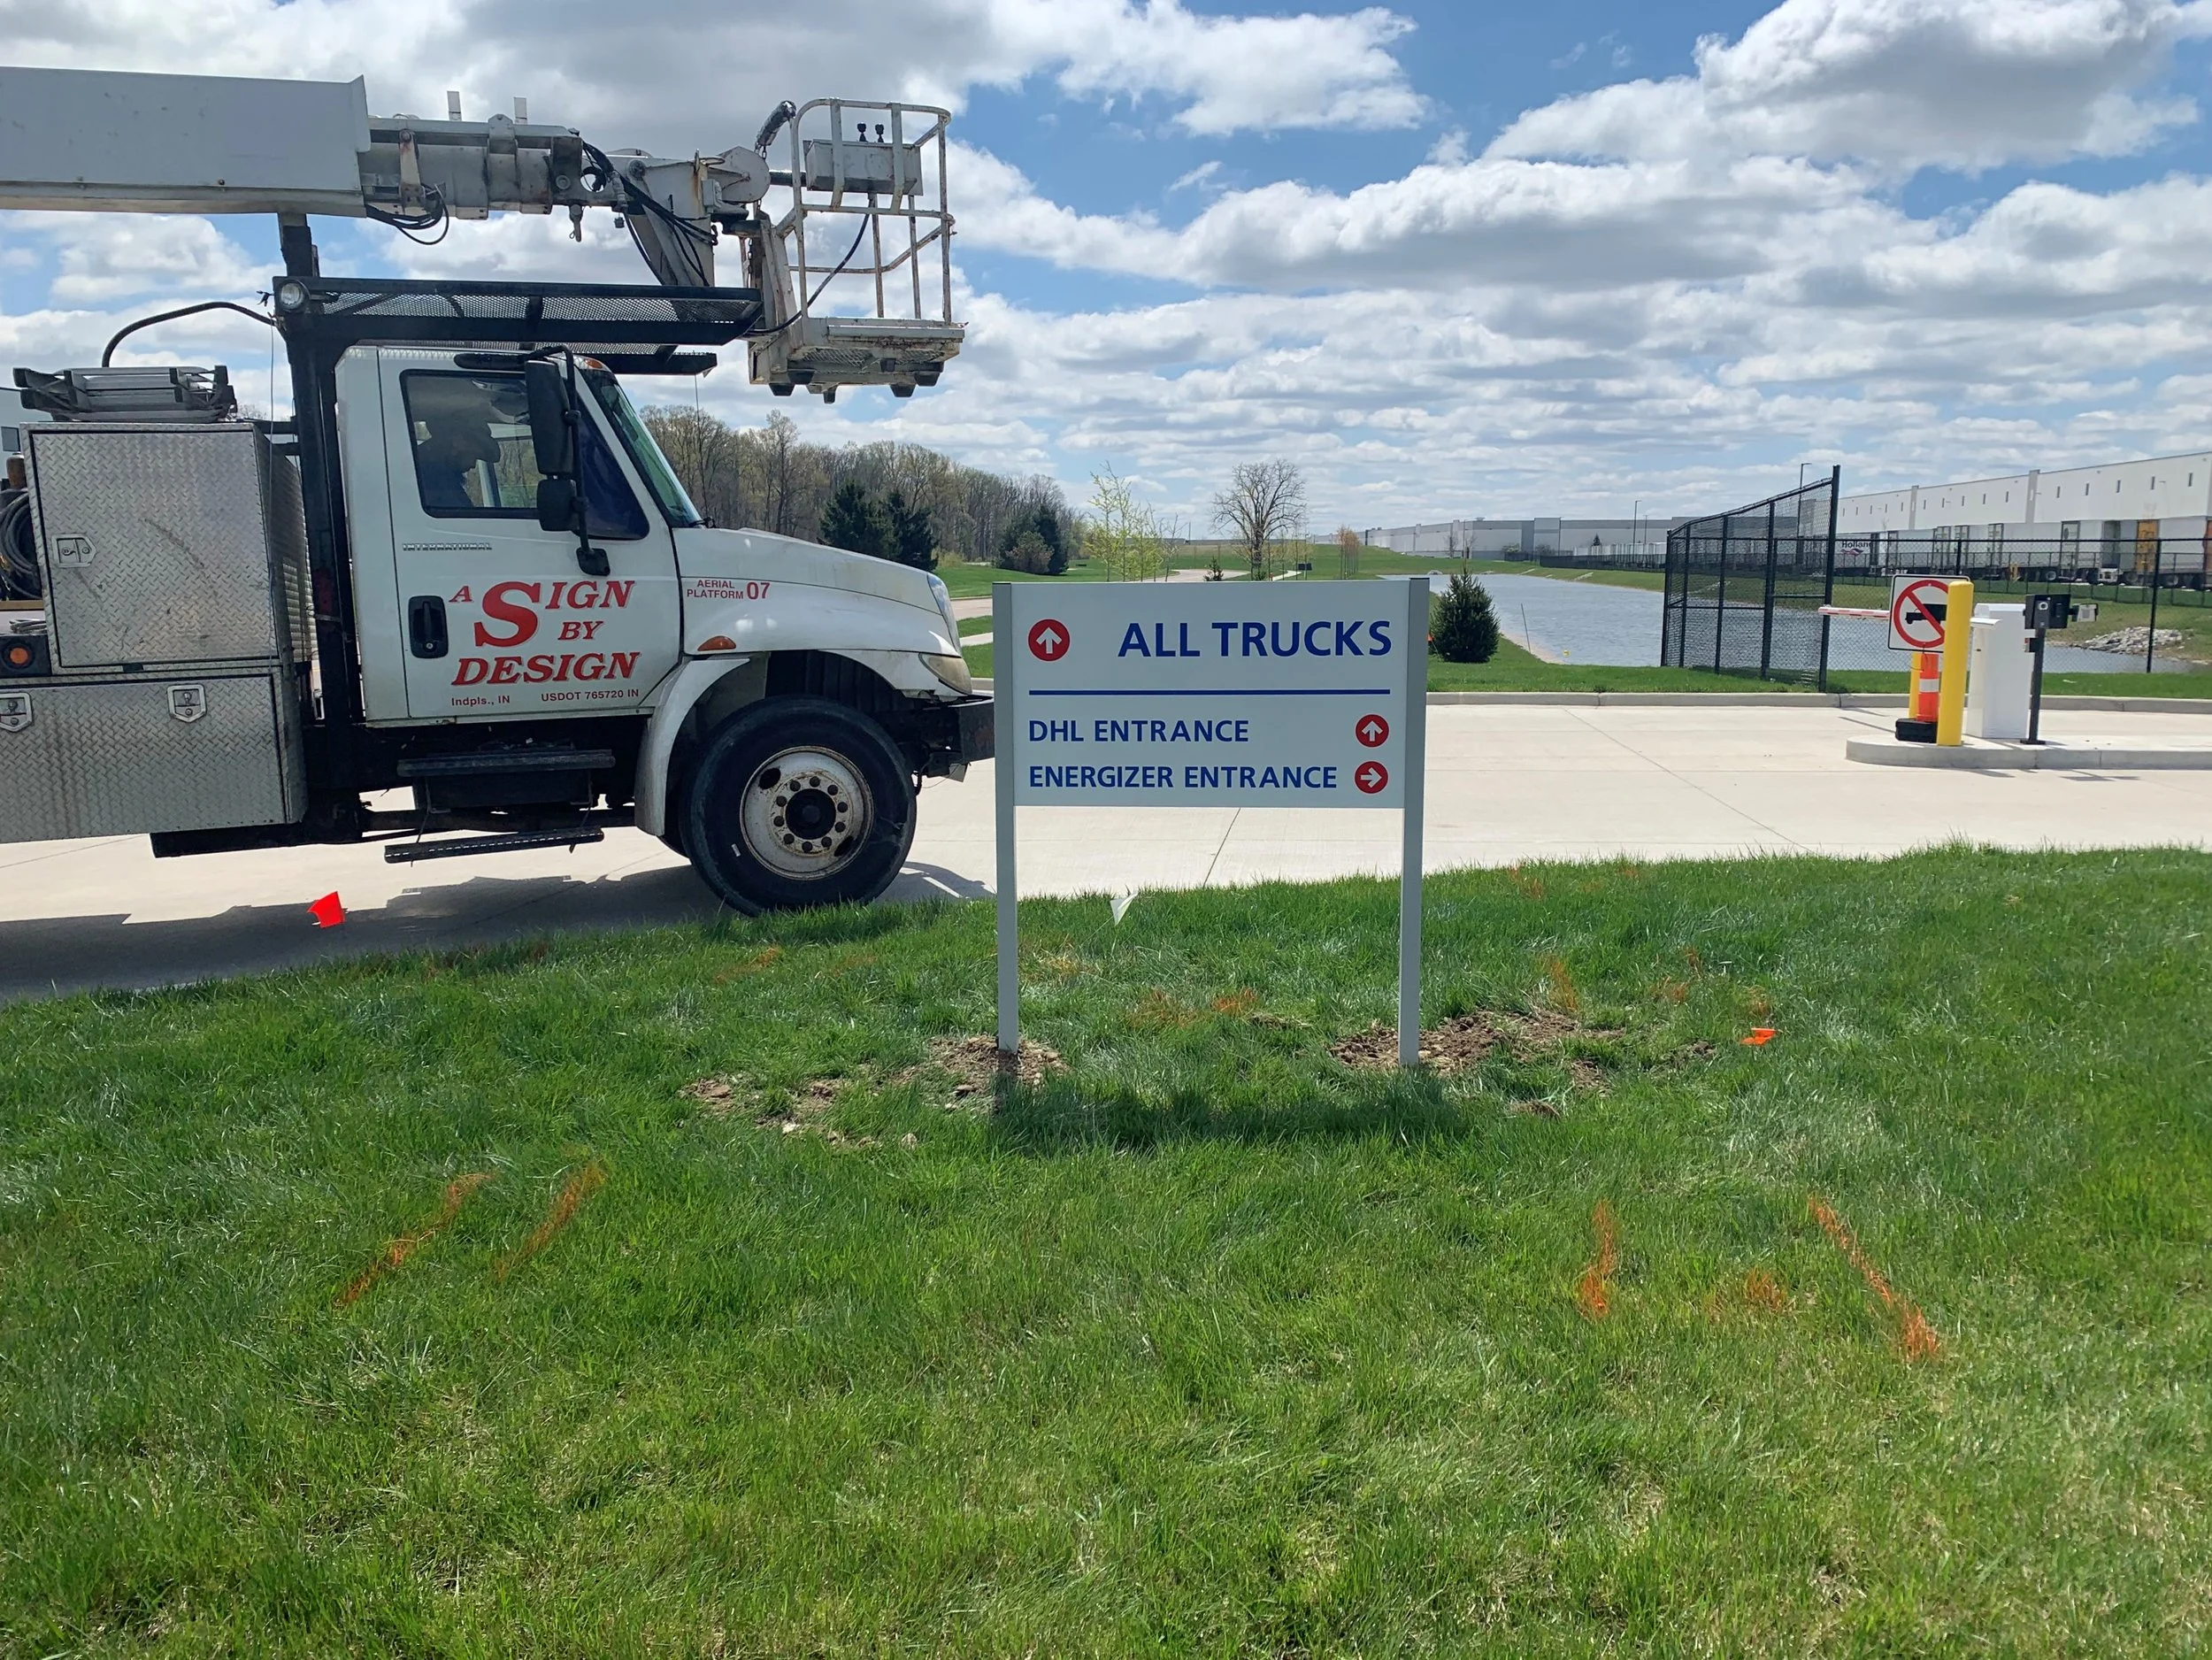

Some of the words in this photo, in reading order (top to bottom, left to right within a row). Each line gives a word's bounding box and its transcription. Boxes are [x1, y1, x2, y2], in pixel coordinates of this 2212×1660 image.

[403, 542, 493, 551] INTERNATIONAL
[687, 588, 743, 599] PLATFORM
[746, 580, 771, 600] 07
[696, 580, 735, 588] AERIAL
[449, 586, 472, 603] A
[474, 580, 635, 647] SIGN
[557, 621, 603, 641] BY
[1118, 622, 1201, 657] ALL
[1211, 620, 1392, 657] TRUCKS
[451, 652, 641, 686] DESIGN
[451, 696, 495, 707] Indpls.,
[498, 696, 511, 704] IN
[541, 692, 580, 702] USDOT
[584, 690, 624, 700] 765720
[1029, 719, 1084, 742] DHL
[1094, 719, 1249, 742] ENTRANCE
[1029, 765, 1174, 788] ENERGIZER
[1184, 765, 1338, 788] ENTRANCE
